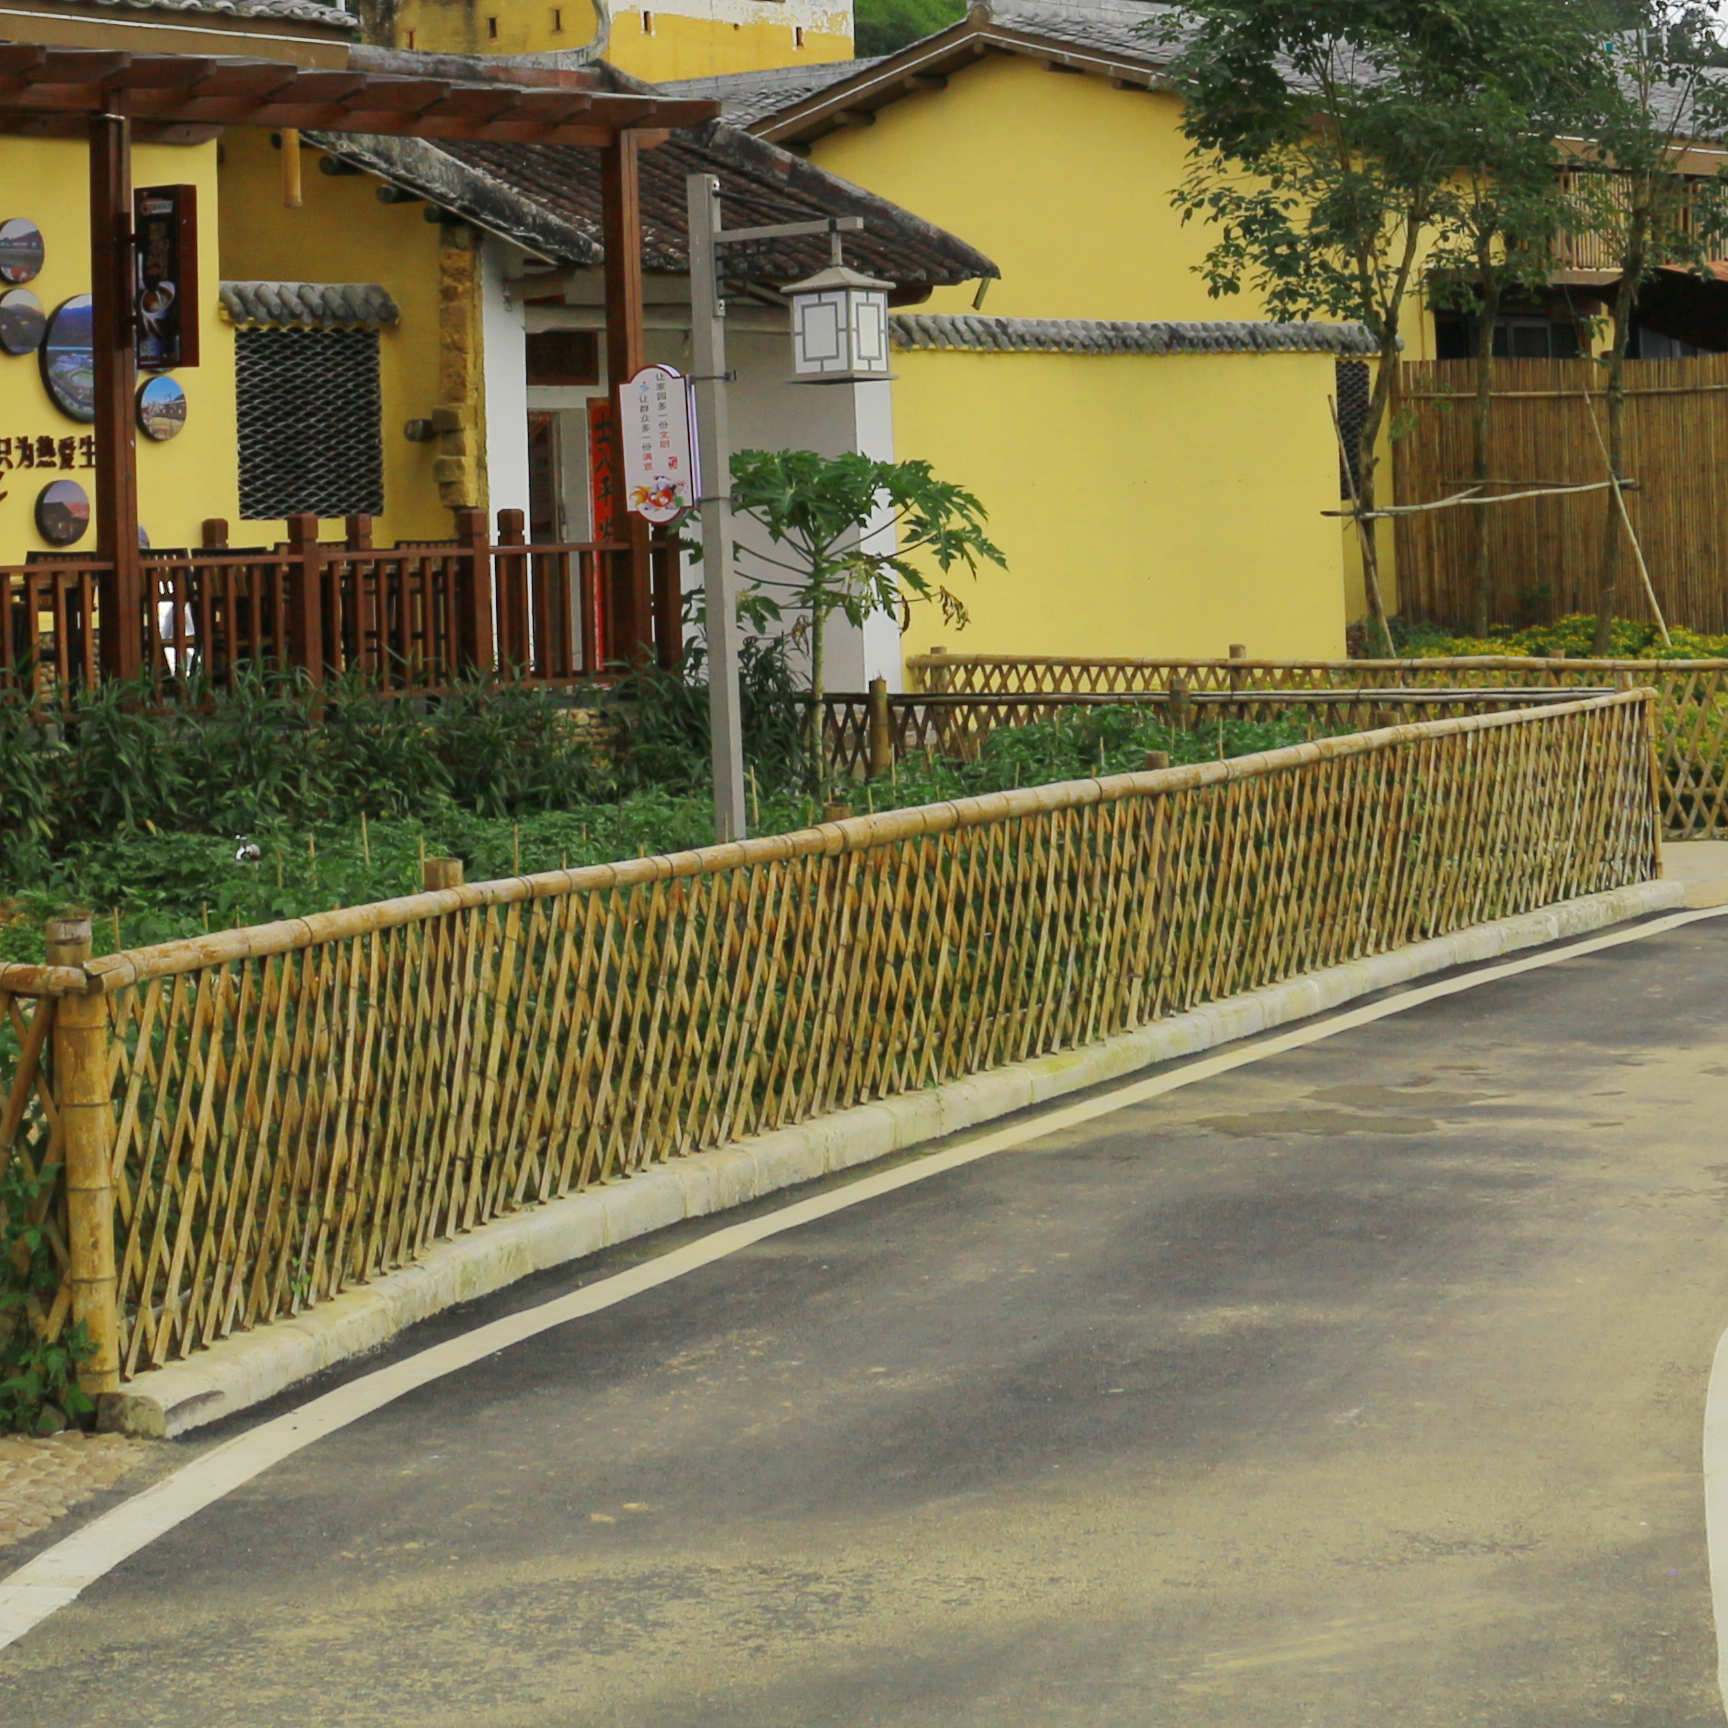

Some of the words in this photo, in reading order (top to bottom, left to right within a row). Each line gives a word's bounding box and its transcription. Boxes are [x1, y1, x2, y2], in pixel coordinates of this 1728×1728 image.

[639, 394, 653, 471] 让群众多一份满意
[656, 373, 670, 448] 让家园多一份文明
